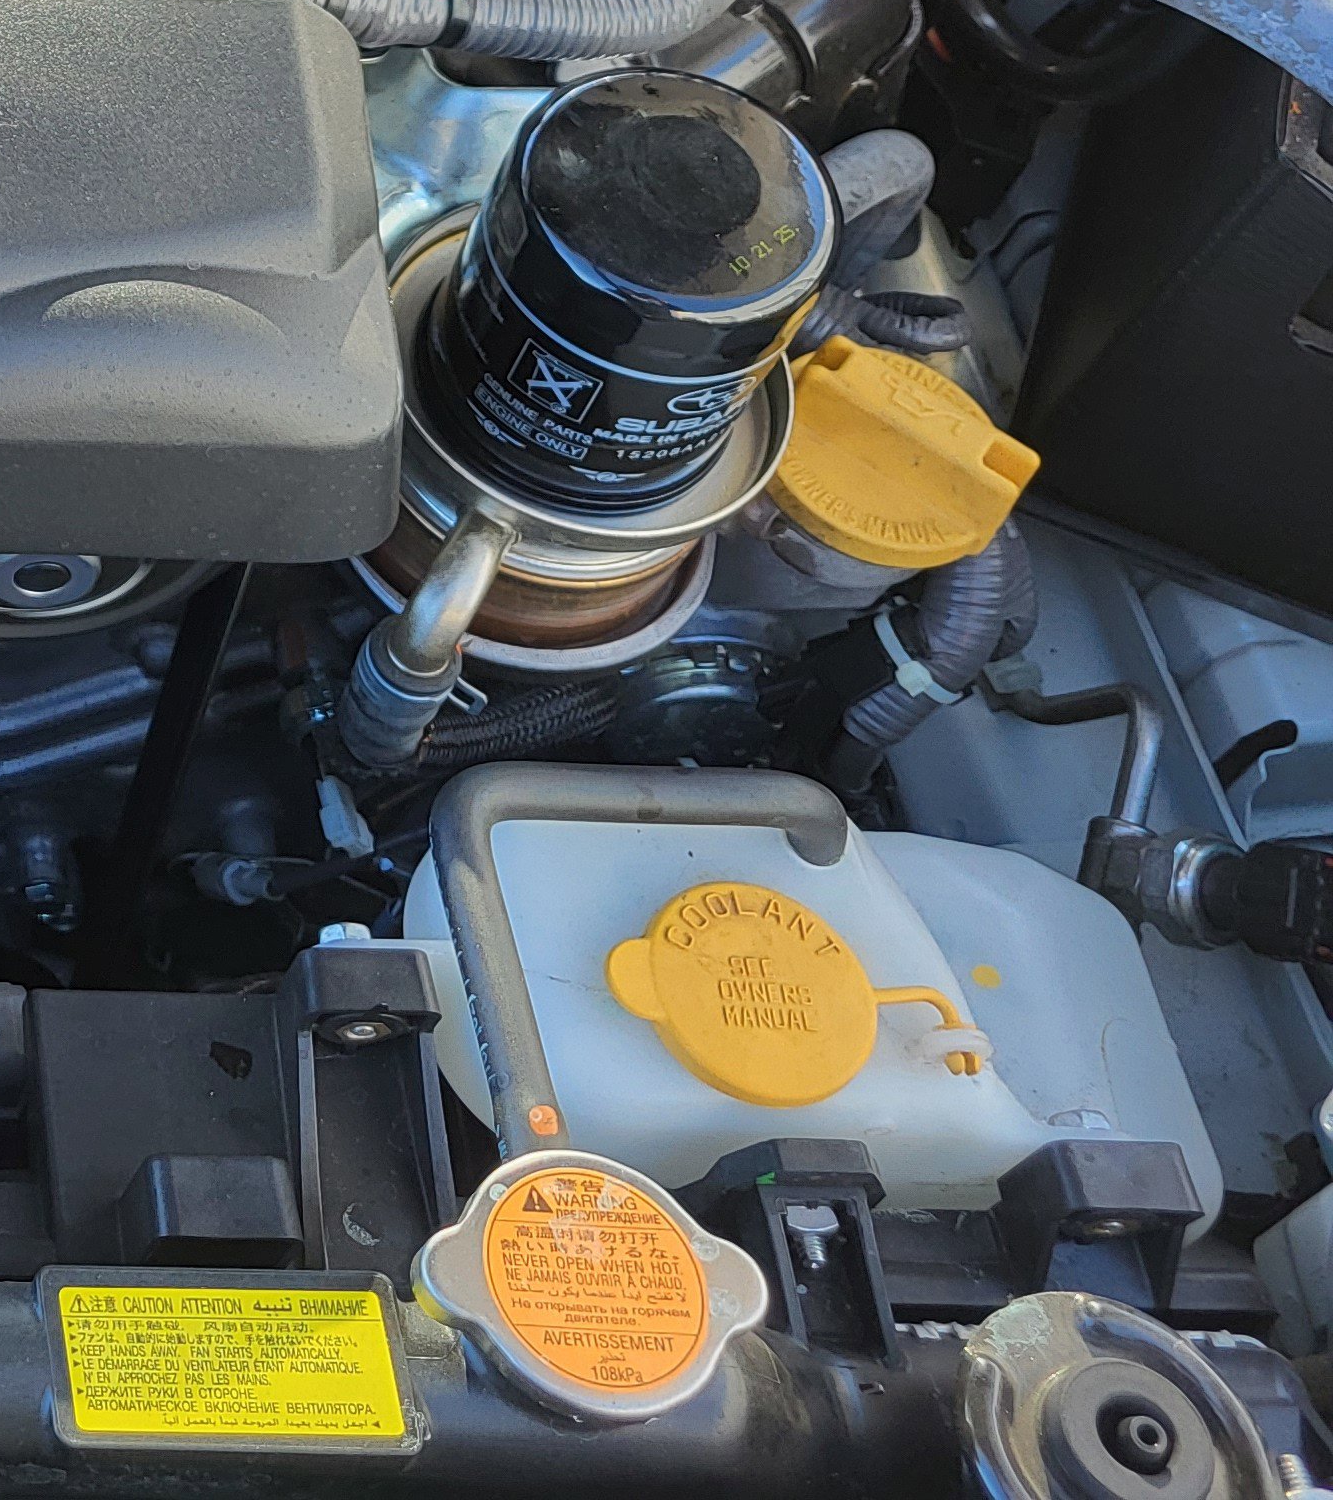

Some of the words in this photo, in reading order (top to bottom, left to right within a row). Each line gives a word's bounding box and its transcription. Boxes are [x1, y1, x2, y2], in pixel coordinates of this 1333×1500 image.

[728, 255, 751, 276] 10
[750, 241, 773, 259] 21
[484, 372, 540, 421] GENUINE
[542, 419, 593, 446] PARTS
[615, 402, 738, 434] SUBA
[477, 386, 533, 436] ENGINE
[535, 432, 583, 457] ONLY
[592, 428, 653, 445] MADE
[656, 433, 681, 447] IN
[864, 515, 948, 545] MANUA
[665, 888, 841, 958] COOLANT
[727, 955, 776, 979] SEE
[717, 978, 814, 1006] OWNERS
[721, 1004, 819, 1032] MANUAL
[552, 1192, 638, 1211] WARNNG
[502, 1252, 549, 1268] NEVER
[555, 1254, 595, 1271] OPEN
[599, 1258, 645, 1275] WHEN
[651, 1261, 684, 1276] HOT.
[505, 1267, 522, 1281] NE
[526, 1269, 571, 1284] JAMAIS
[576, 1272, 622, 1287] OUVRIR
[639, 1274, 688, 1291] CHAUD.
[89, 1294, 118, 1314] 注意
[122, 1296, 174, 1314] CAUTION
[180, 1296, 243, 1316] ATTENTION
[299, 1298, 369, 1317] ВНИМАНИЕ
[534, 1300, 608, 1316] открывать
[80, 1344, 105, 1357] KEEP
[110, 1345, 146, 1358] HANDS
[150, 1345, 181, 1358] AWAY.
[190, 1346, 210, 1358] FAN
[214, 1346, 253, 1359] STARTS
[260, 1347, 343, 1360] AUTOMATICALLY.
[542, 1329, 675, 1353] AVERTISSEMENT
[82, 1358, 95, 1370] LE
[98, 1356, 161, 1371] DÉMARRAGE
[165, 1359, 180, 1371] DU
[184, 1360, 250, 1373] VENTILATEUR
[253, 1357, 284, 1373] ÉTANT
[289, 1361, 364, 1375] AUTOMATIQUE.
[590, 1364, 644, 1384] 108kPa
[97, 1372, 111, 1384] EN
[117, 1372, 178, 1385] APPROCHEZ
[185, 1373, 205, 1385] PAS
[211, 1373, 230, 1386] LES
[236, 1374, 272, 1387] MAINS.
[85, 1386, 142, 1400] ДЕРЖИТЕ
[148, 1387, 180, 1399] РУКИ
[185, 1388, 194, 1399] В
[87, 1399, 198, 1412] АВТОМАТИЧЕСКОЕ
[204, 1401, 280, 1414] ВКЛЮЧЕНИЕ
[286, 1402, 376, 1416] ВЕНТИЛЯТОРА.
